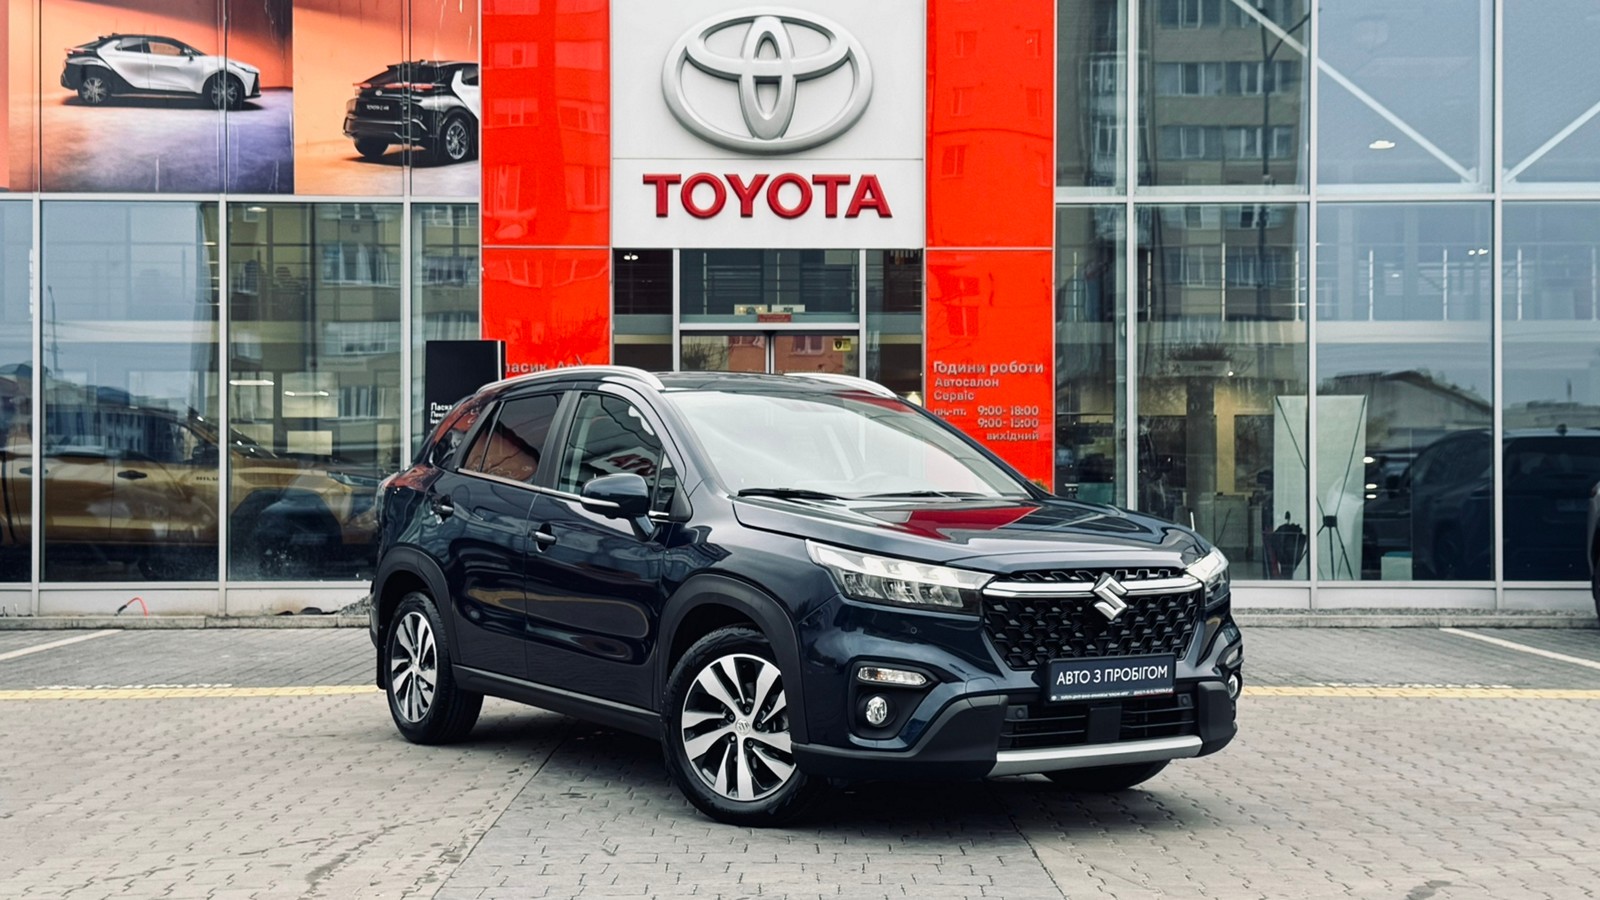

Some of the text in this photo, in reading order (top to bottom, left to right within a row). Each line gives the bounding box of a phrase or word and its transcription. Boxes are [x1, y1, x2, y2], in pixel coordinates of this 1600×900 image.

[643, 172, 893, 220] TOYOTA
[933, 361, 1044, 376] Години роботи
[934, 377, 999, 388] Автосалон
[933, 390, 975, 403] Сервіс
[1010, 405, 1039, 416] 18:00
[1010, 418, 1039, 428] 15:00
[986, 430, 1039, 441] вихідний
[1056, 665, 1168, 686] АВТО З ПРОБІГОМ
